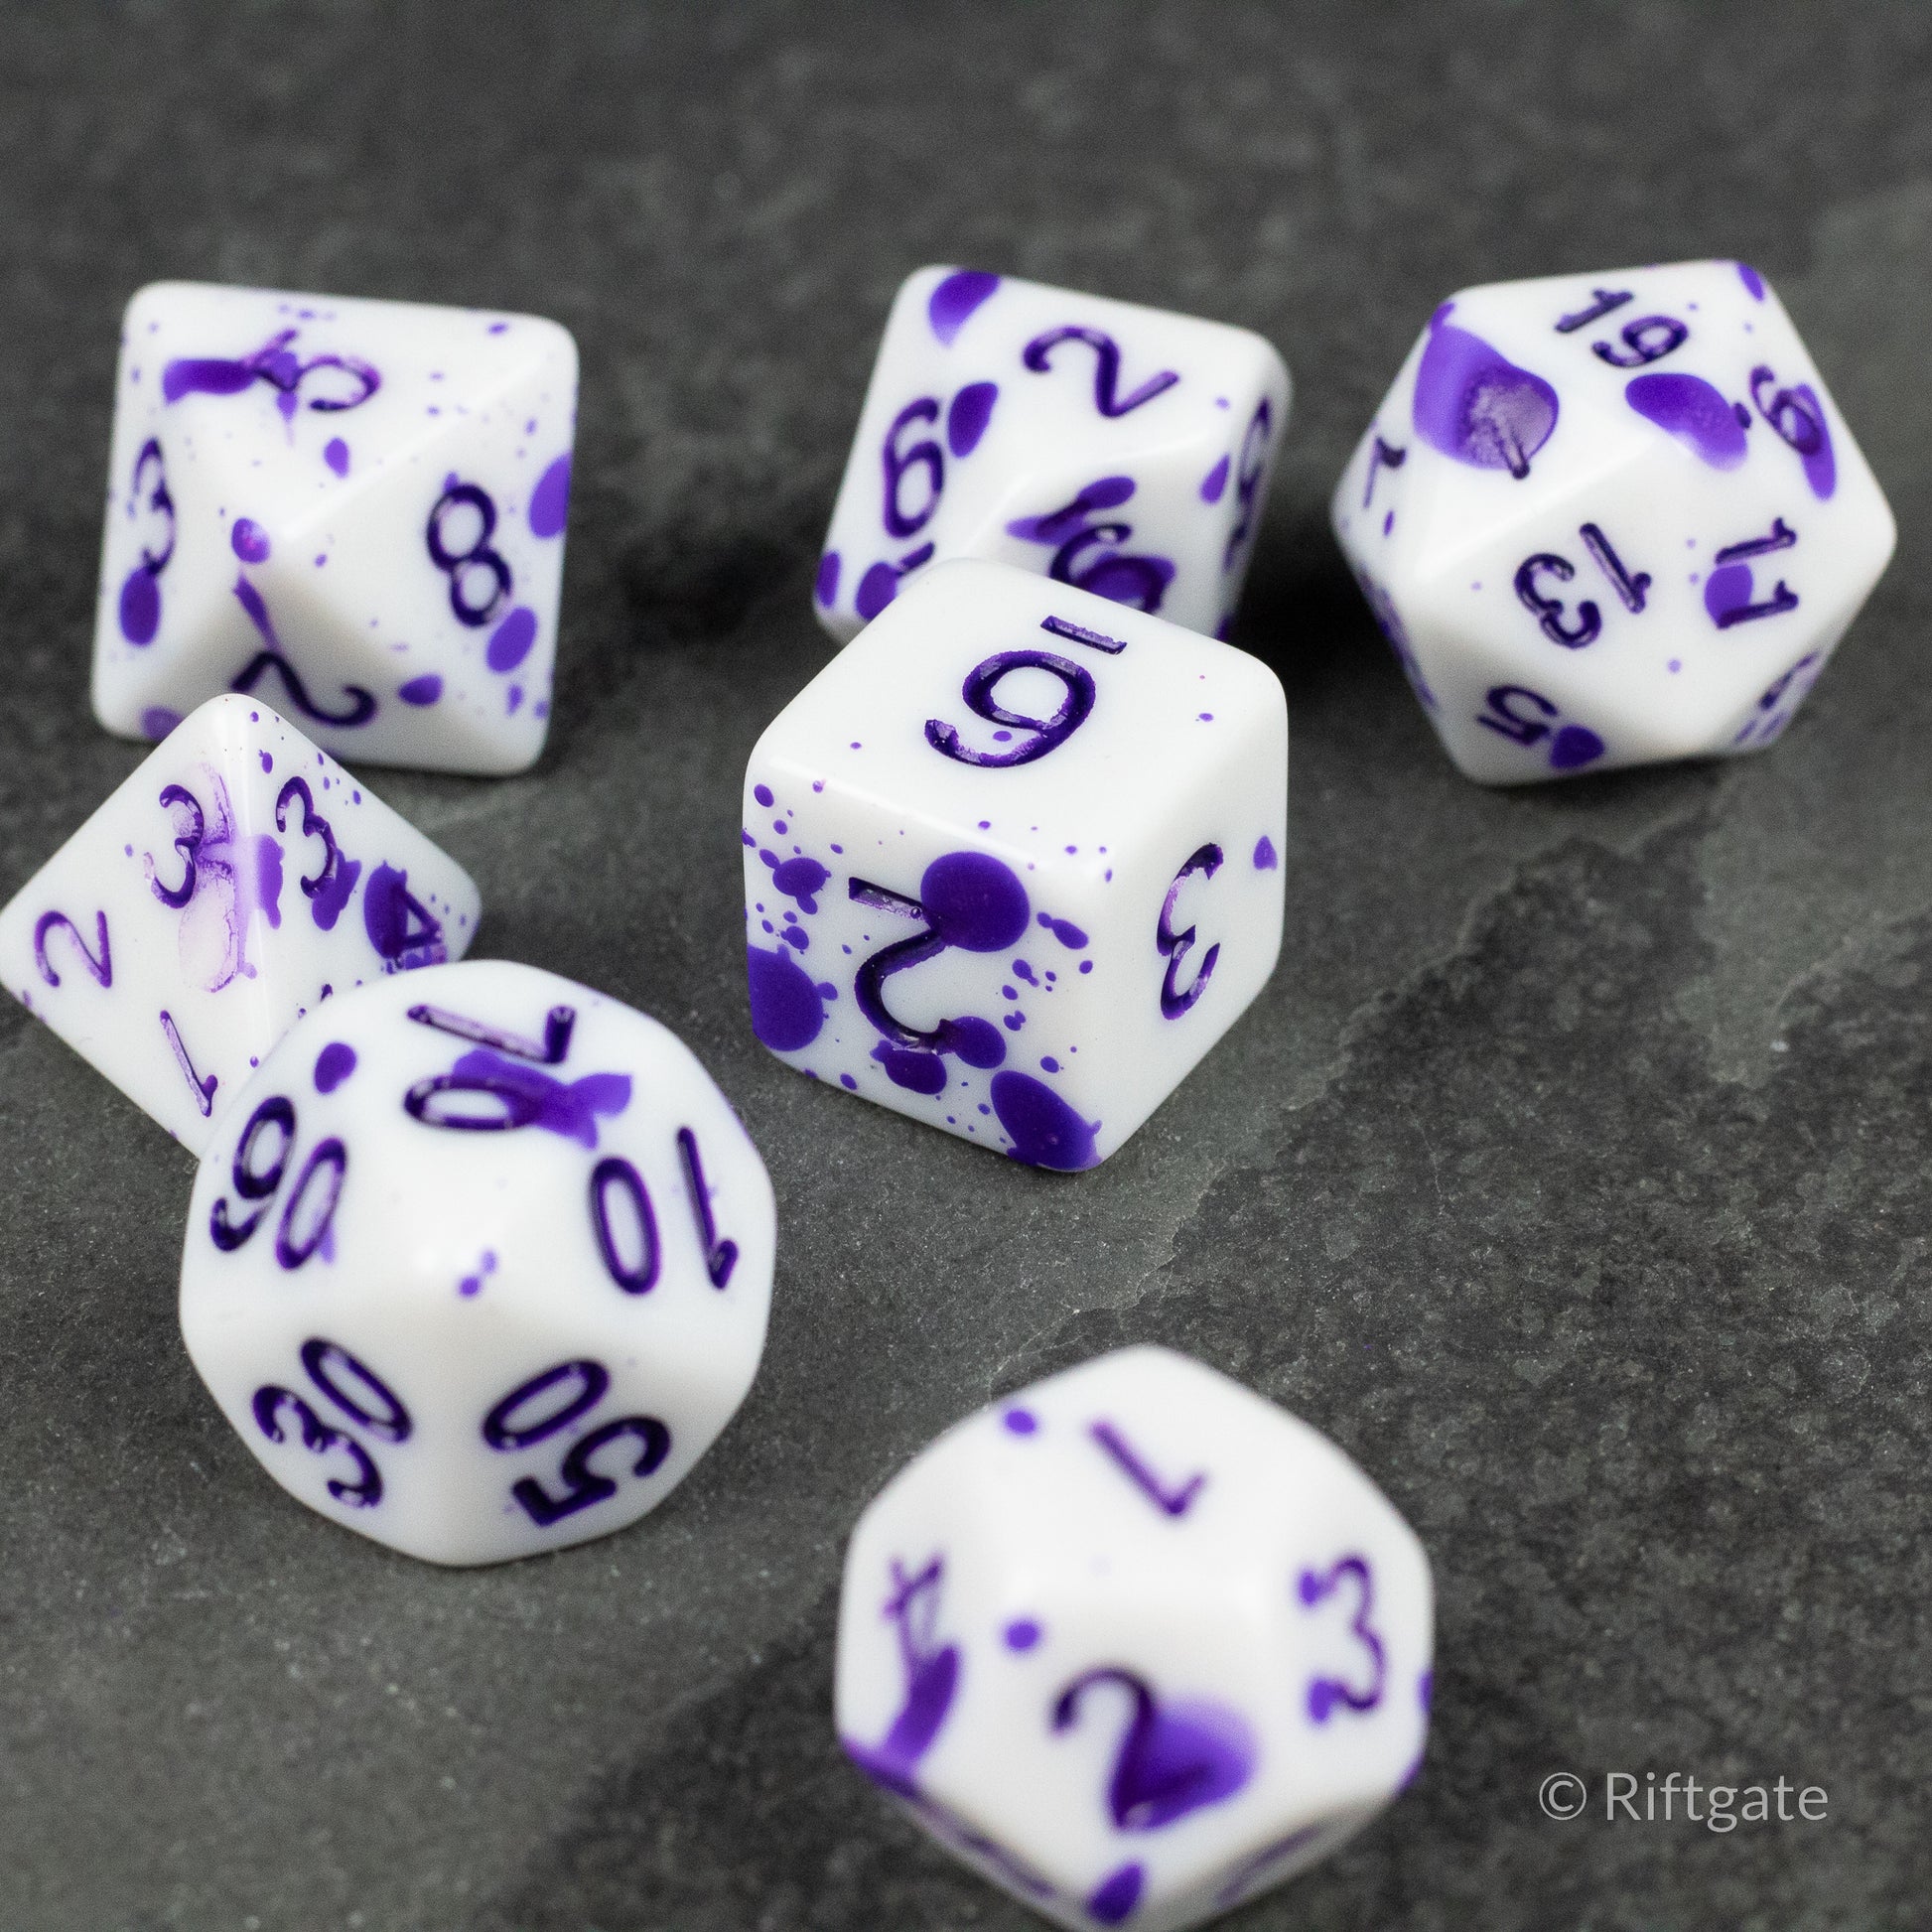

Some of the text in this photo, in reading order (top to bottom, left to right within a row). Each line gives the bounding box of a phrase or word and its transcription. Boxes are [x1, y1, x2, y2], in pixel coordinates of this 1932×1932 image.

[1023, 325, 1182, 418] 2
[1555, 289, 1688, 367] 19
[882, 396, 944, 539] 6
[426, 483, 514, 629] 8
[1513, 522, 1652, 649] 13
[144, 783, 205, 909] 3
[275, 775, 339, 899] 3
[34, 909, 113, 989] 2
[1156, 842, 1225, 1022] 3
[252, 1337, 413, 1509] 30
[482, 1358, 672, 1527] 50
